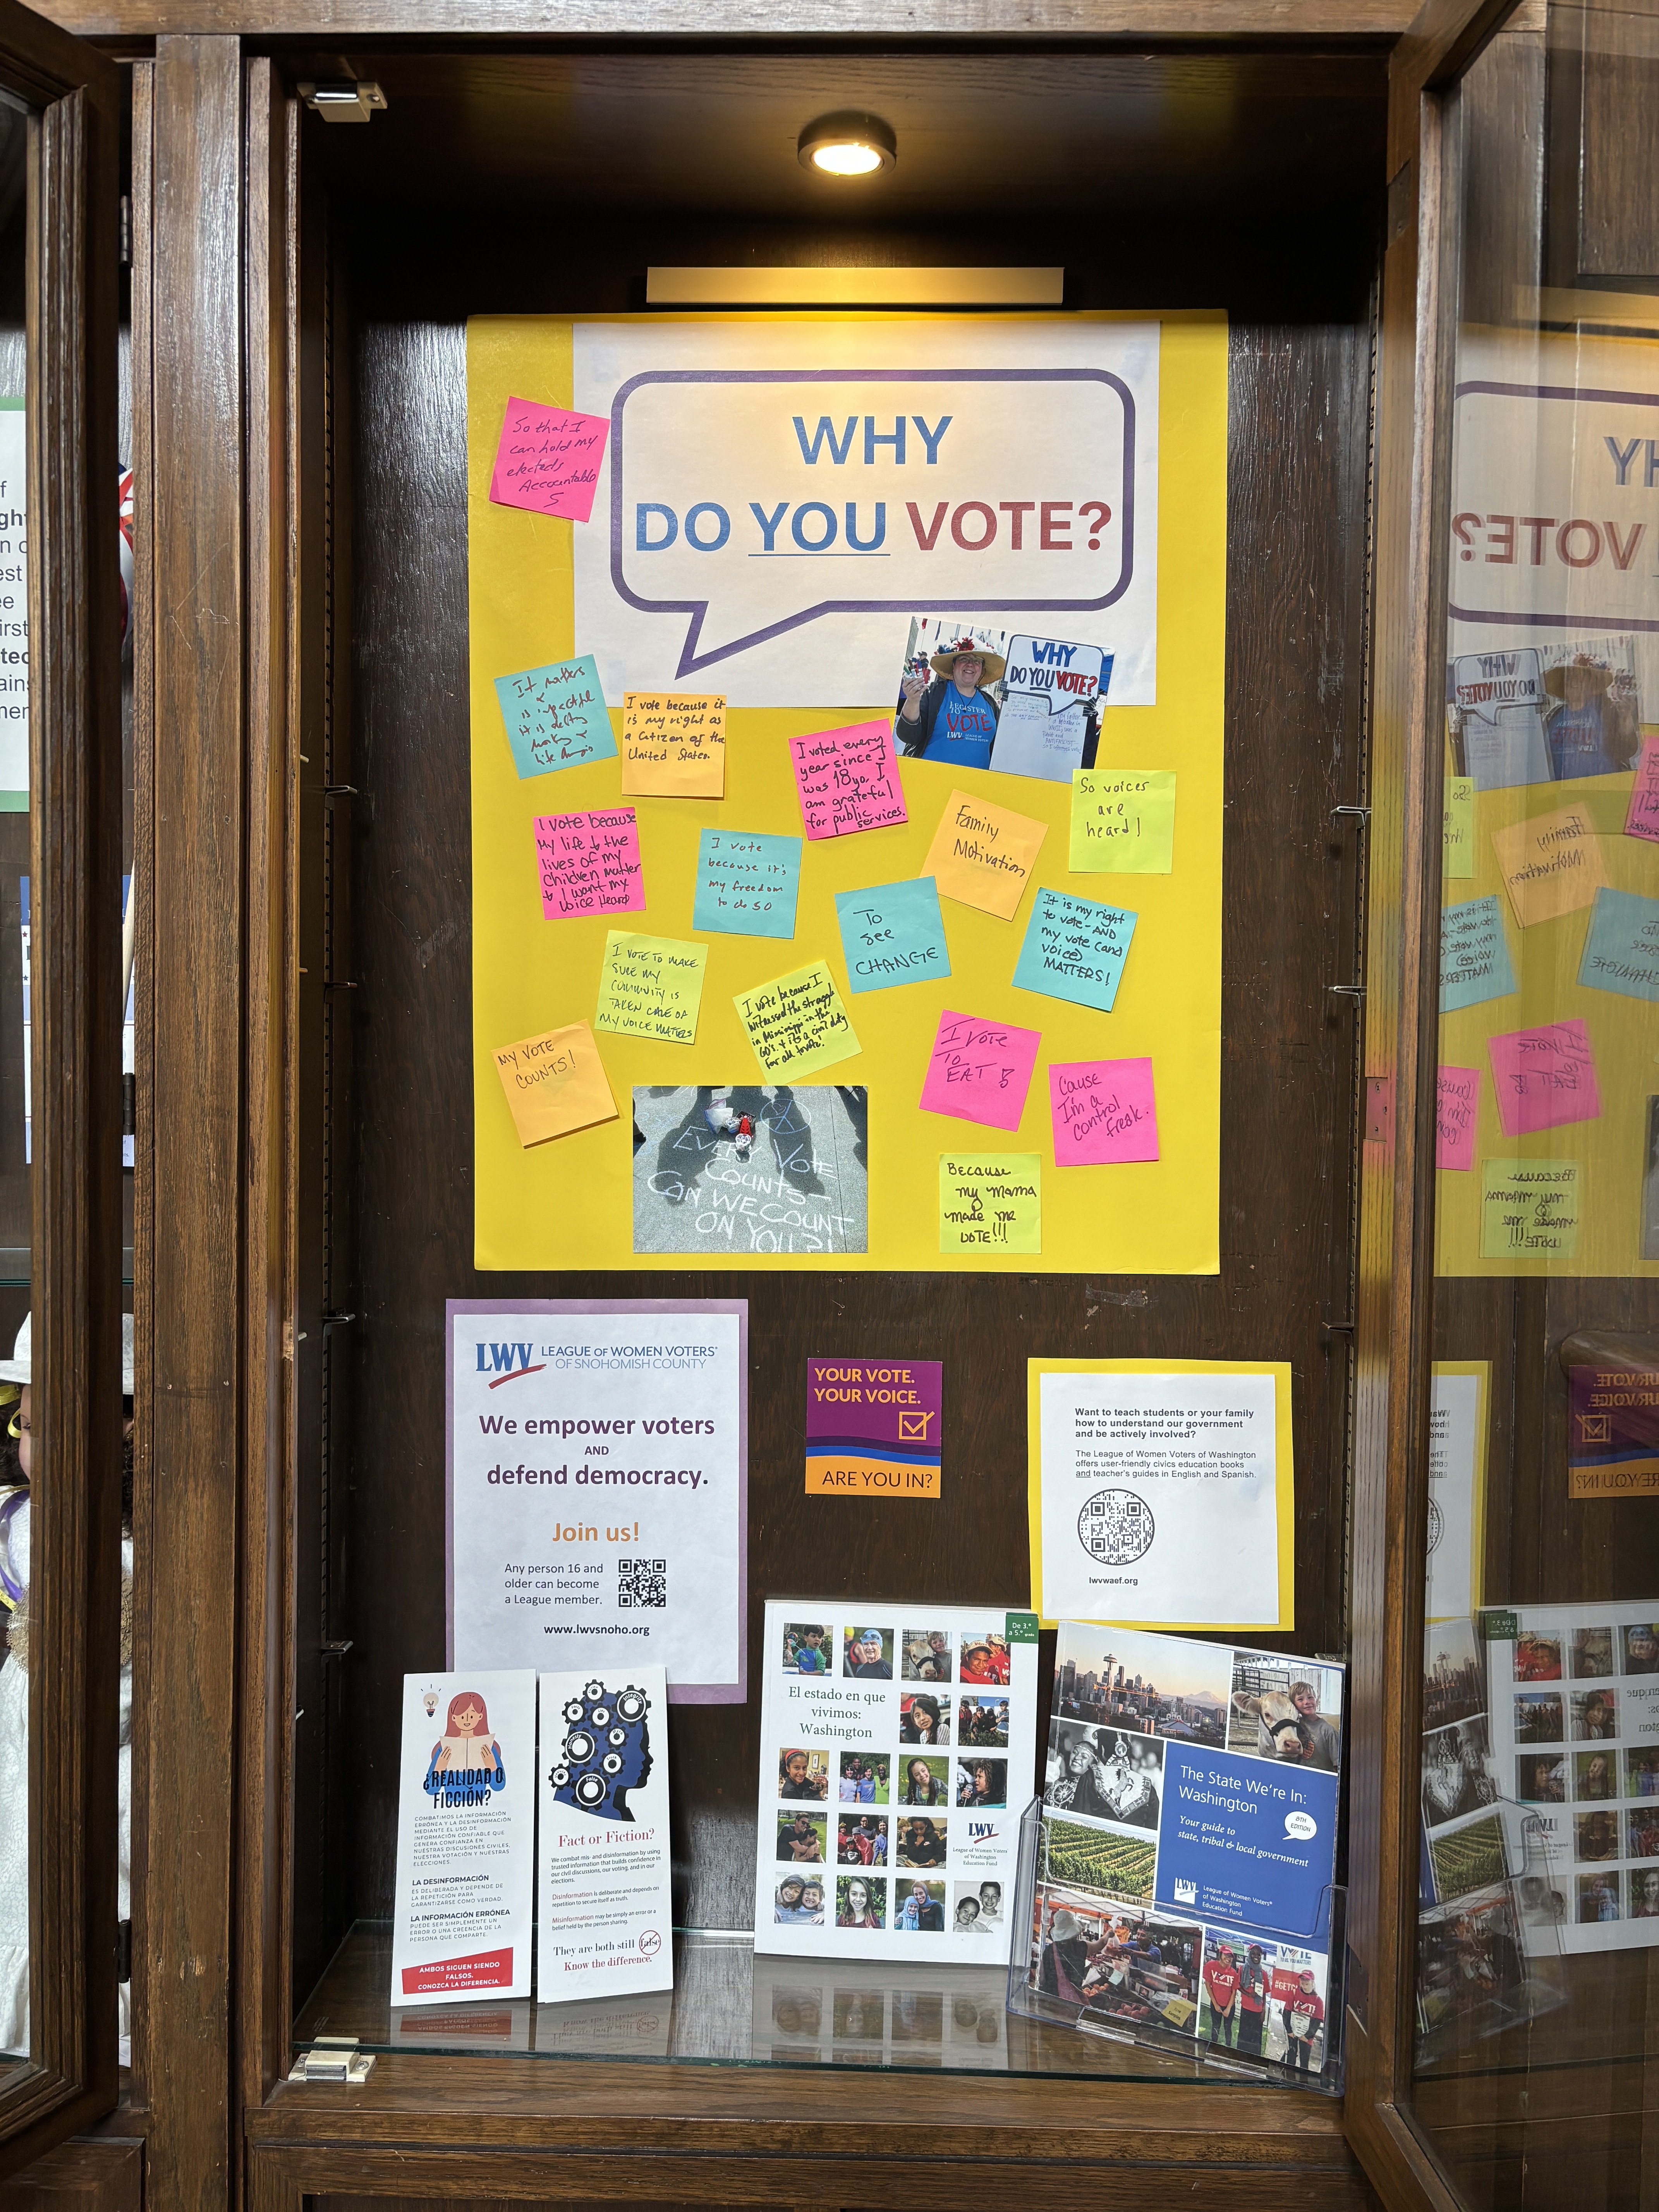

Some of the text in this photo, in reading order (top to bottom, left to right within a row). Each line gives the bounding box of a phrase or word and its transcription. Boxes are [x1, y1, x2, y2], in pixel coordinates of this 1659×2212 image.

[792, 416, 953, 464] WHY
[636, 501, 1112, 552] DO YOU VOTE?
[1032, 641, 1077, 668] WHY
[1010, 666, 1097, 697] DO YOU VOTE?
[946, 713, 992, 732] VOTE
[1080, 777, 1149, 794] So voices
[1098, 803, 1124, 816] are
[955, 805, 999, 843] Family
[711, 837, 762, 852] I vote
[708, 857, 786, 875] because it's
[953, 838, 1025, 878] Motivation
[709, 880, 783, 893] my freedom
[718, 897, 727, 907] to
[733, 899, 747, 908] do
[853, 909, 882, 926] To
[860, 929, 895, 946] see
[856, 947, 938, 975] CHANGE
[498, 1040, 554, 1070] MY VOTE
[516, 1049, 575, 1089] COUNTS!
[947, 1163, 1011, 1176] Because
[955, 1187, 983, 1212] my
[944, 1205, 1016, 1223] made me
[476, 1343, 534, 1371] LWV
[541, 1346, 591, 1357] LEAGUE
[594, 1348, 608, 1357] OF
[610, 1346, 663, 1357] WOMEN
[555, 1358, 706, 1369] OF SNOHOMISH COUNTY
[814, 1368, 915, 1384] YOUR VOTE.
[814, 1388, 921, 1404] YOUR VOICE.
[1075, 1408, 1099, 1417] Want
[1114, 1408, 1140, 1417] teach
[1200, 1410, 1223, 1419] your
[1225, 1409, 1254, 1419] family
[479, 1415, 714, 1439] We empower voters
[1186, 1421, 1243, 1429] government
[1110, 1430, 1147, 1439] actively
[584, 1446, 609, 1455] AND
[487, 1465, 708, 1489] defend democracy.
[822, 1471, 933, 1489] ARE YOU IN?
[552, 1522, 639, 1542] Join us!
[505, 1563, 603, 1575] Any person 16 and
[505, 1579, 532, 1589] older
[557, 1579, 599, 1589] become
[1089, 1577, 1138, 1586] lwvwaef.org
[514, 1595, 551, 1606] League
[555, 1594, 603, 1605] member.
[544, 1624, 650, 1637] www.lwvsnoho.org
[623, 1693, 643, 1704] Integrity
[788, 1686, 886, 1705] El estado en que
[811, 1707, 862, 1719] vivimos:
[799, 1723, 872, 1740] Washington
[568, 1733, 582, 1750] Honesty
[423, 1767, 503, 1790] ¿REALIDAD O
[1180, 1765, 1306, 1804] The State We're In:
[434, 1786, 491, 1809] FICCIÓN?
[1179, 1785, 1257, 1814] Washington
[969, 1823, 995, 1836] LWV
[1180, 1815, 1235, 1836] Your guide to
[1290, 1823, 1310, 1832] EDITION
[558, 1828, 654, 1847] Fact or Fiction?
[1178, 1831, 1199, 1843] state,
[1202, 1835, 1224, 1848] tribal
[1236, 1843, 1255, 1855] local
[1257, 1849, 1309, 1867] government
[423, 1874, 489, 1885] DESINFORMACIÓN
[422, 1911, 474, 1920] INFORMACIÓN
[476, 1909, 510, 1917] ERRÓNEA
[553, 1946, 576, 1957] They
[579, 1946, 593, 1954] are
[595, 1941, 615, 1952] both
[617, 1939, 634, 1950] still
[564, 1956, 652, 1971] Know the difference.
[461, 1979, 500, 1987] DIFERENCIA.
